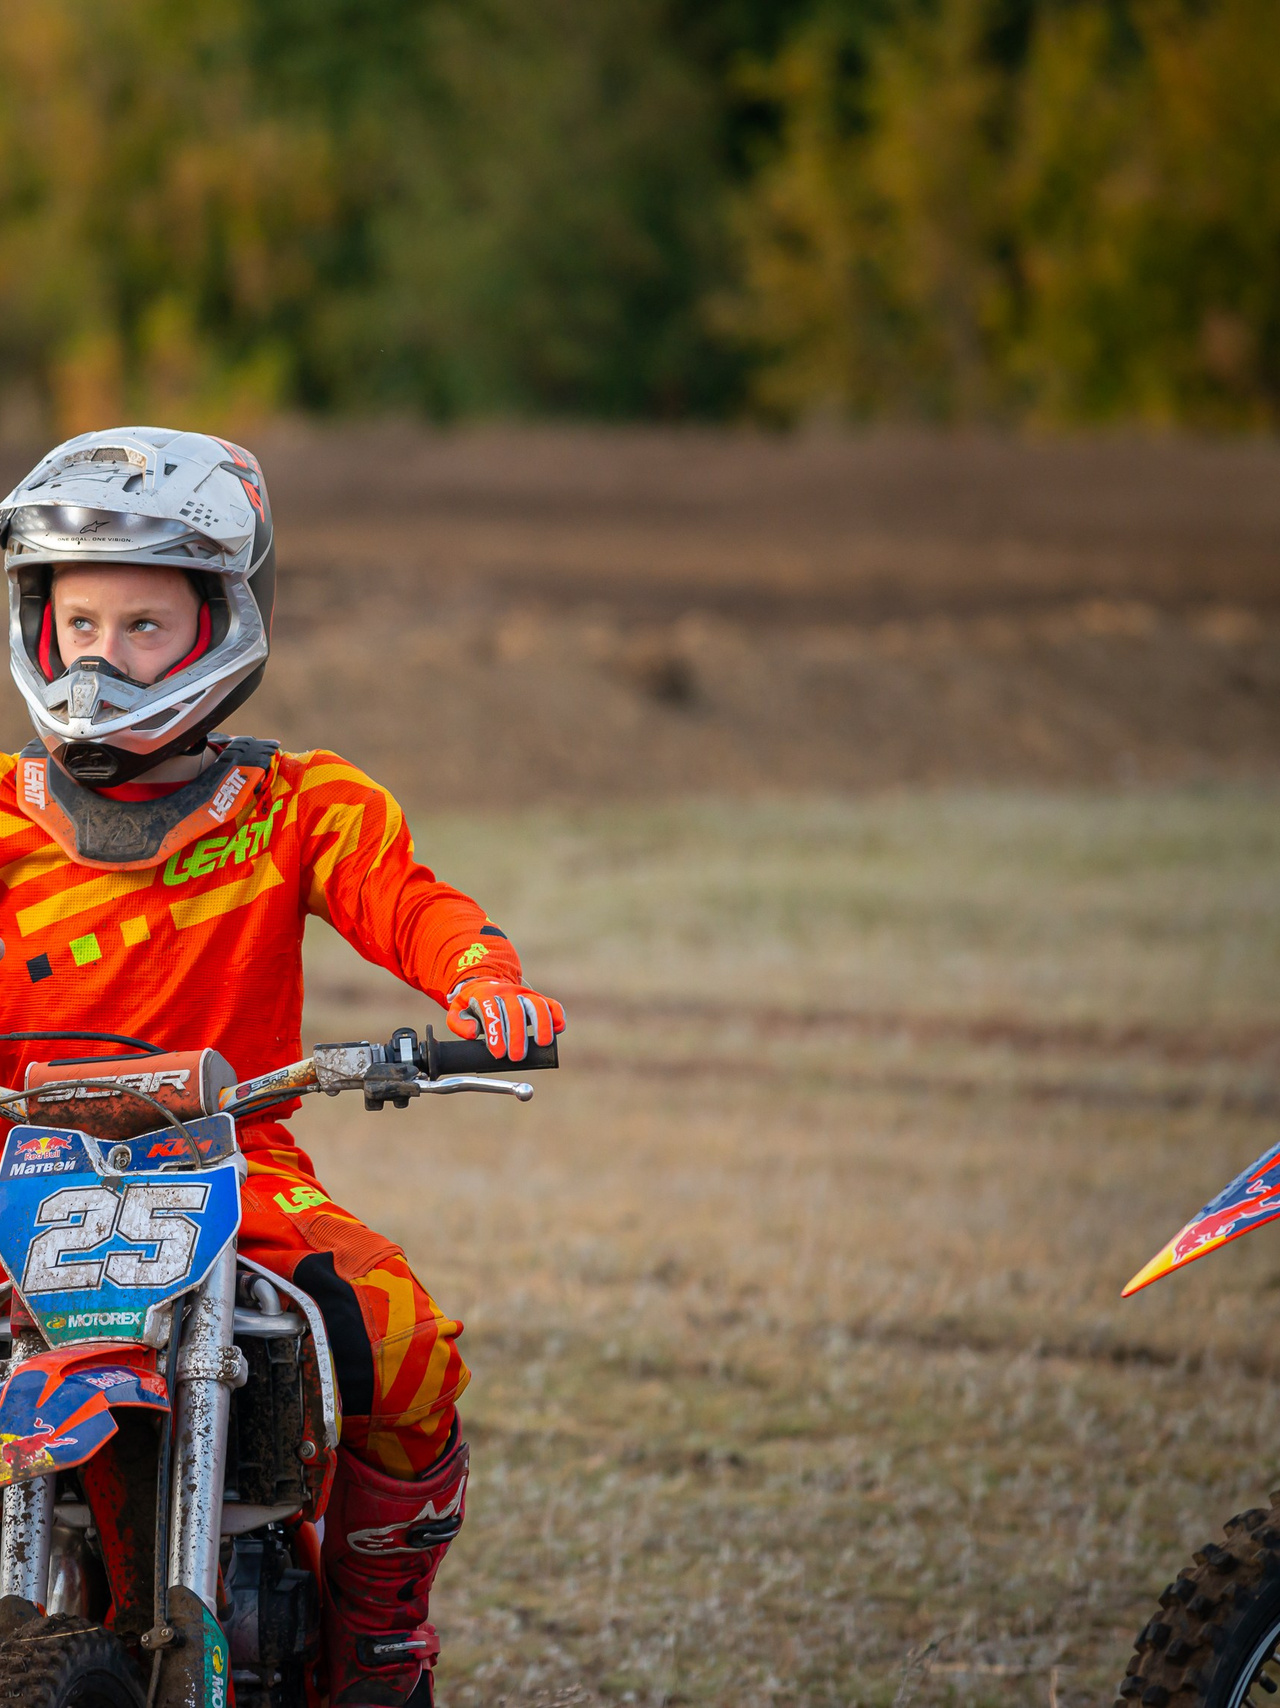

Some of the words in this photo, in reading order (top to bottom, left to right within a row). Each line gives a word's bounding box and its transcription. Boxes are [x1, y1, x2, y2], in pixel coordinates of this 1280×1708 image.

[208, 768, 246, 823] LEATT
[37, 1069, 191, 1102] SCAR
[250, 1069, 289, 1092] SCAR
[9, 1157, 77, 1177] Матвей
[24, 1152, 43, 1161] Red
[44, 1150, 61, 1159] Bull
[23, 1182, 212, 1295] 25
[68, 1312, 144, 1328] MOTOREX
